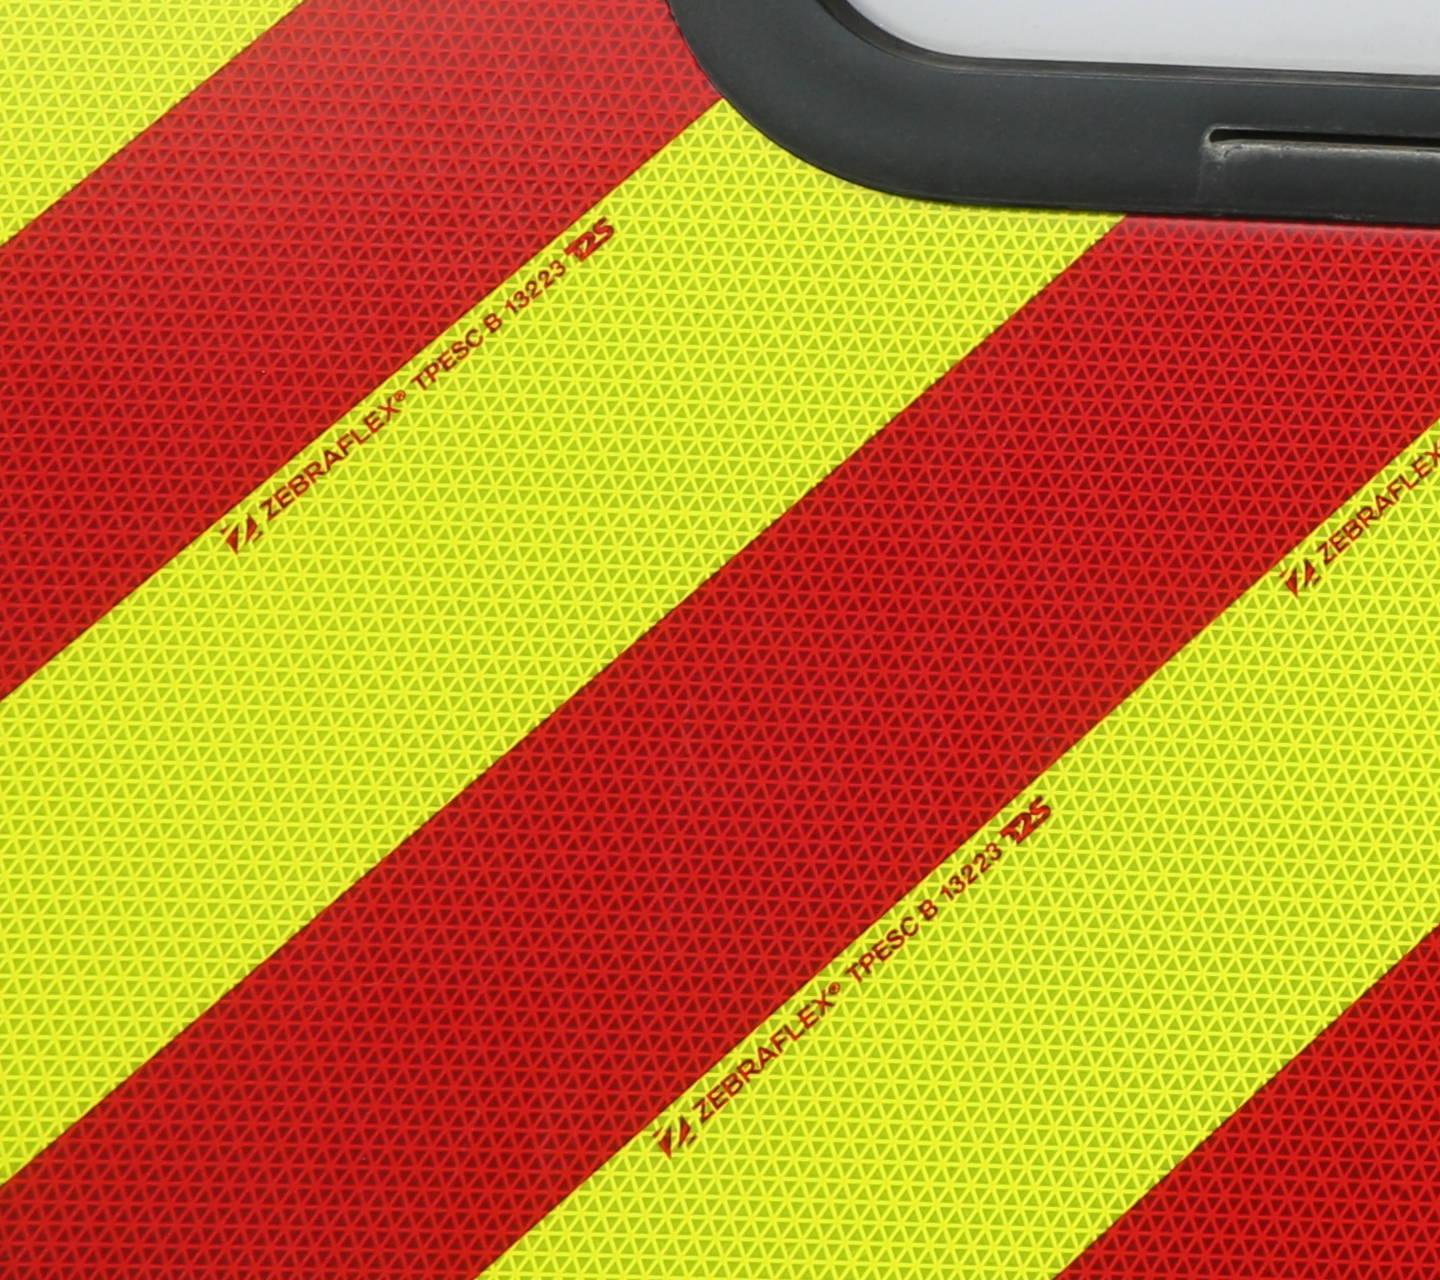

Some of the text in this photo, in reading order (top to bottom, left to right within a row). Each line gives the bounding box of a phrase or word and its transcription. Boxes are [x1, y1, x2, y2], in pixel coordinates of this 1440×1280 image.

[411, 331, 485, 391] TPESC
[481, 311, 504, 334] B
[503, 258, 567, 315] 13223
[846, 922, 917, 983] TPESC
[917, 898, 939, 921] B
[939, 841, 1003, 900] 13223
